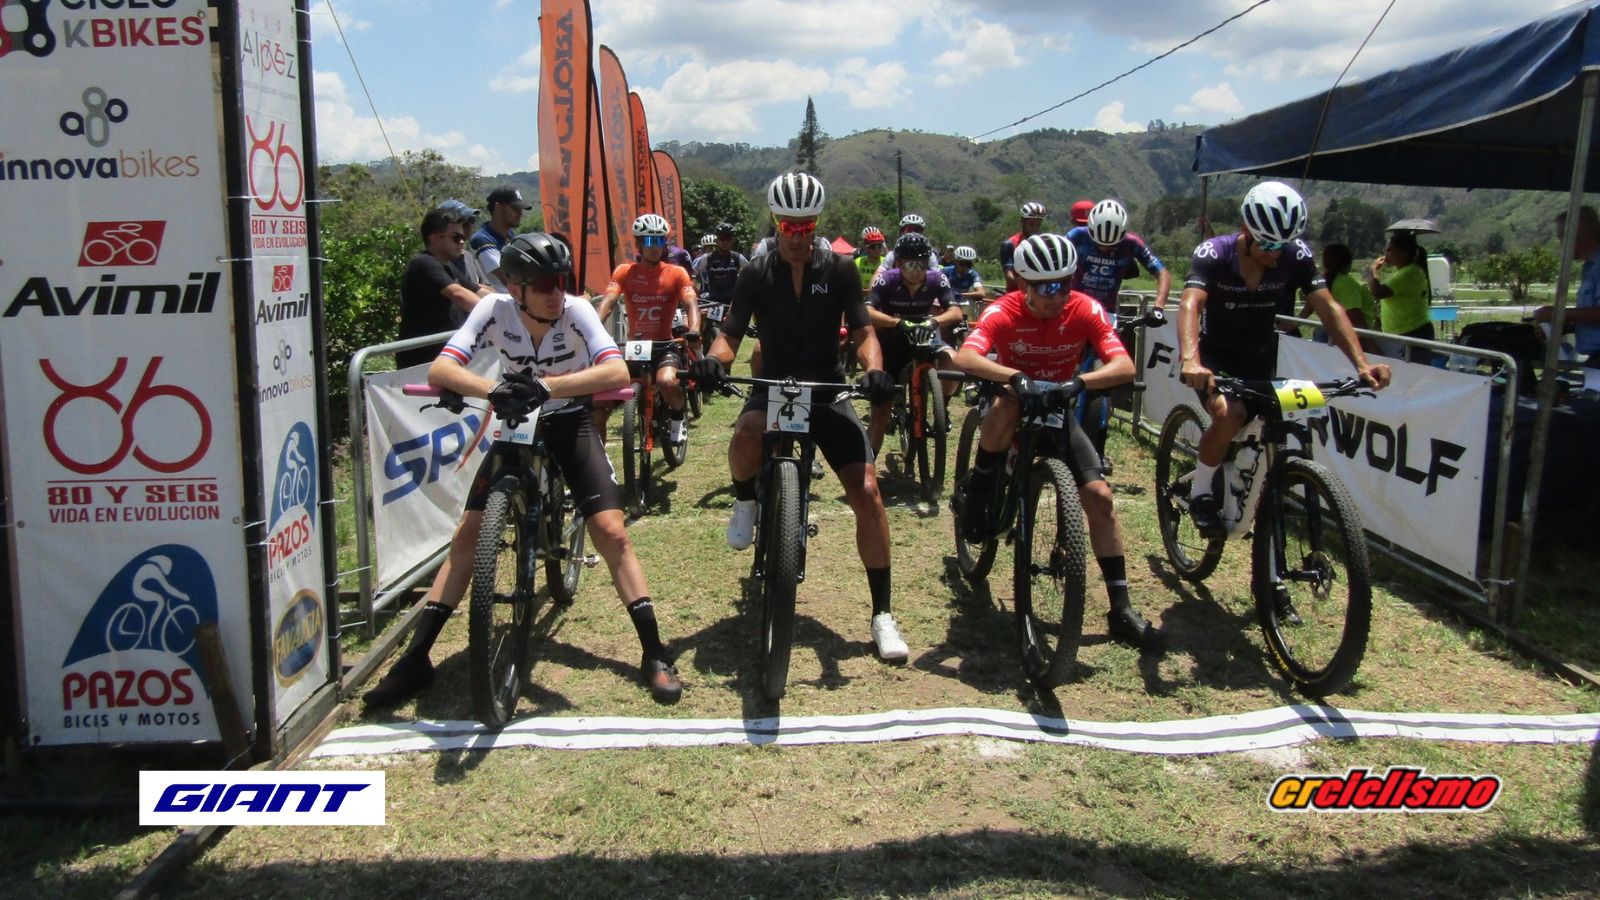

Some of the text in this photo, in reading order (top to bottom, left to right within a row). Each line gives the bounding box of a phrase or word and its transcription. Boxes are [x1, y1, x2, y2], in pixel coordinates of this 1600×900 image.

[63, 16, 205, 48] KBIKES
[270, 220, 278, 235] Y
[283, 220, 306, 235] SEIS
[253, 236, 308, 249] VIDA EN EVOLUCION
[2, 271, 222, 317] Avimil
[256, 293, 309, 325] Avimil
[634, 344, 642, 355] 9
[1292, 388, 1308, 410] 5
[105, 485, 129, 504] Y
[145, 483, 219, 503] SEIS
[49, 505, 220, 523] VIDA EN EVOLUCION
[268, 514, 310, 570] PAZOS
[63, 668, 195, 711] PAZOS
[64, 712, 200, 729] BICIS Y MOTOS
